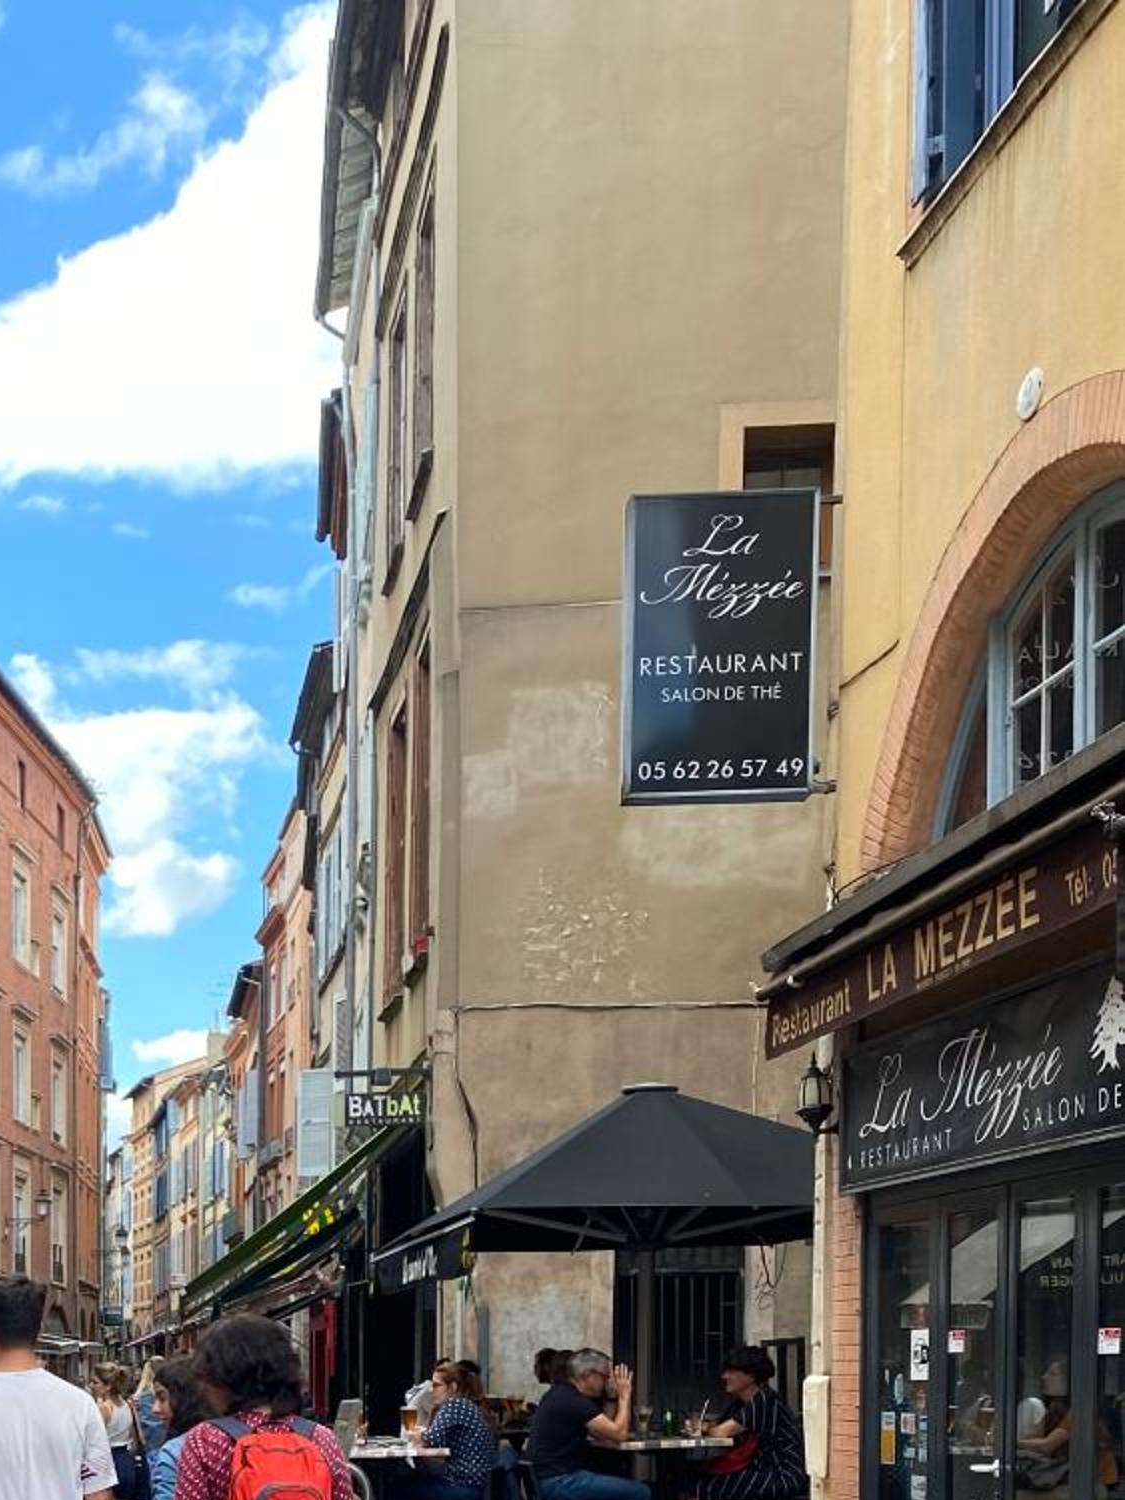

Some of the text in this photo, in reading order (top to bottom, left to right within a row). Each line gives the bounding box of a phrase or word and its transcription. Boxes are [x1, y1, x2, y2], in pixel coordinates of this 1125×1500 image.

[682, 513, 760, 557] La
[639, 652, 803, 676] RESTAURANT
[661, 686, 720, 703] SALON
[724, 685, 747, 701] DE
[638, 757, 804, 781] 05 62 26 57 49
[772, 979, 851, 1049] Restaurant
[866, 944, 898, 1001] LA
[859, 1052, 912, 1138] La
[859, 1083, 1122, 1169] RESTAURANT SALON DE
